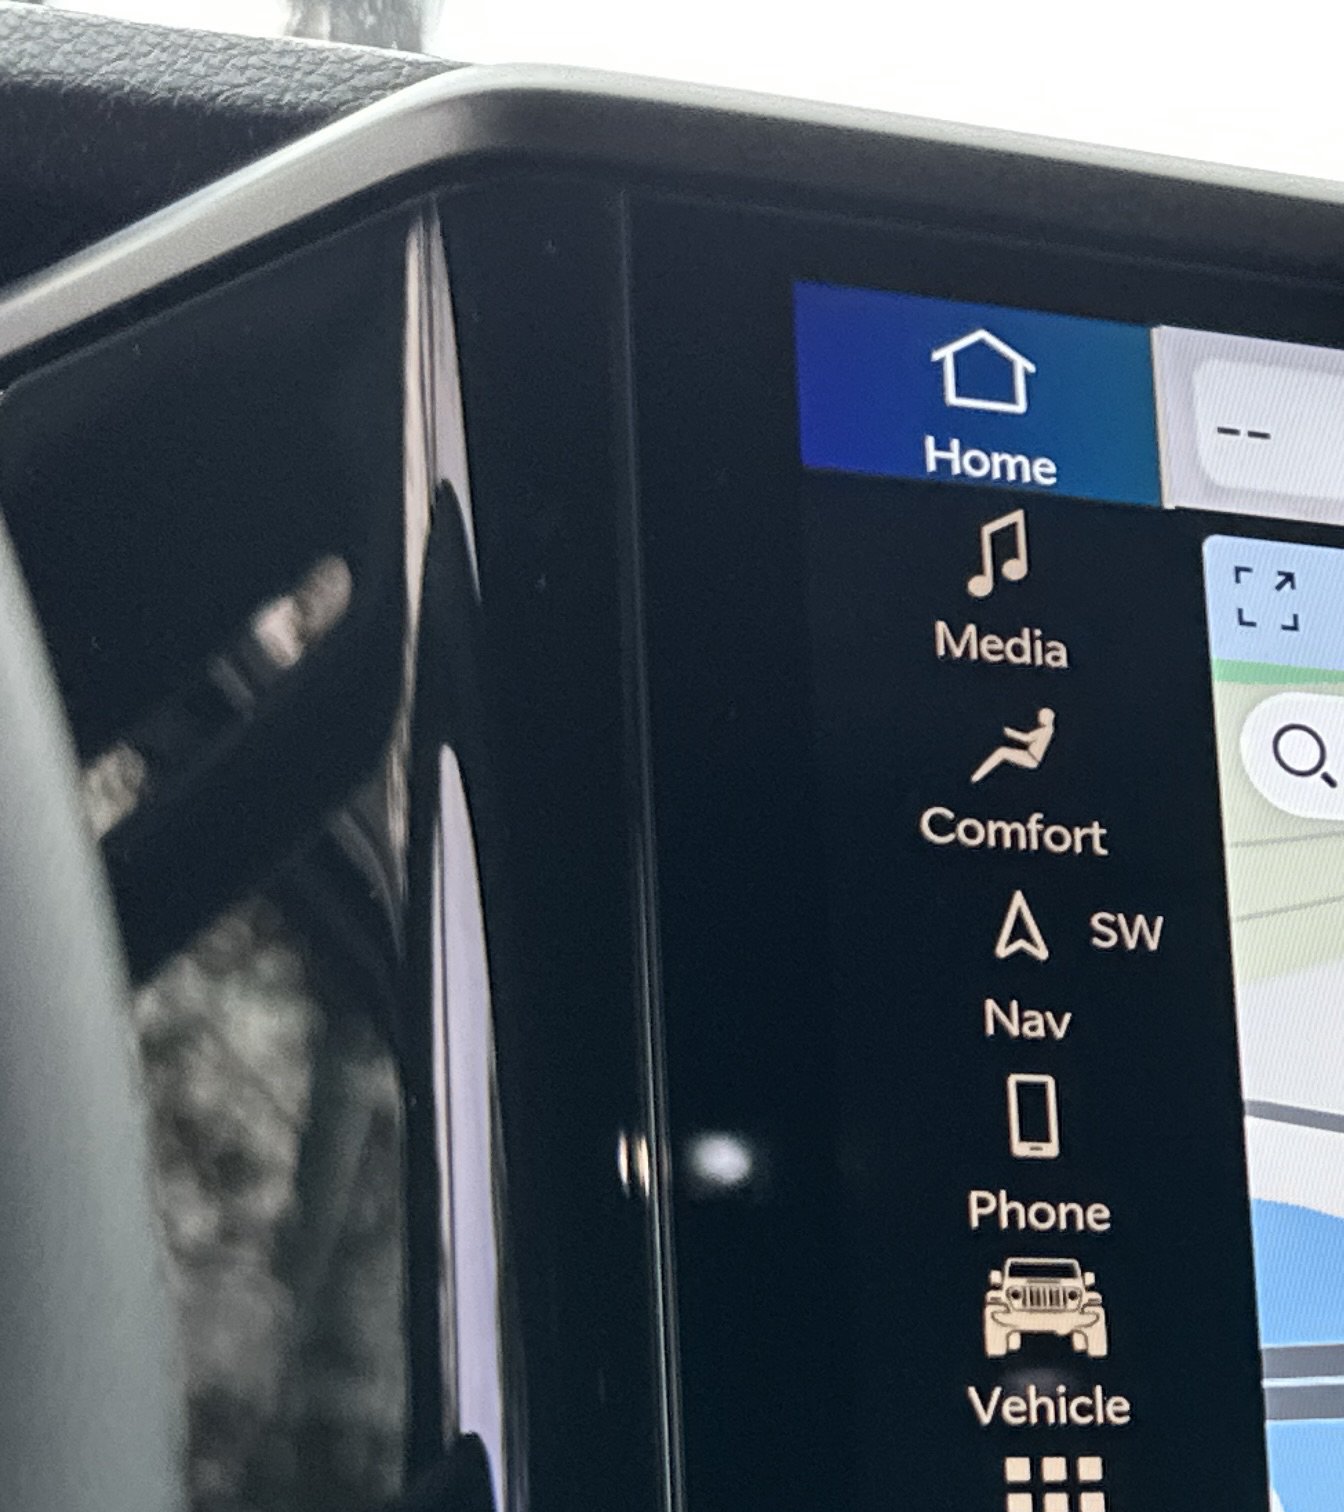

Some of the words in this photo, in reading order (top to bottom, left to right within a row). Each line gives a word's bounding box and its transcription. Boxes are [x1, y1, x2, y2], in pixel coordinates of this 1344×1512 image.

[924, 435, 1057, 486] Home
[933, 620, 1070, 669] Media
[919, 806, 1108, 857] Comfort
[1090, 911, 1164, 951] SW
[984, 998, 1072, 1040] Nav
[968, 1189, 1111, 1233] Phone
[967, 1384, 1132, 1427] Vehicle
